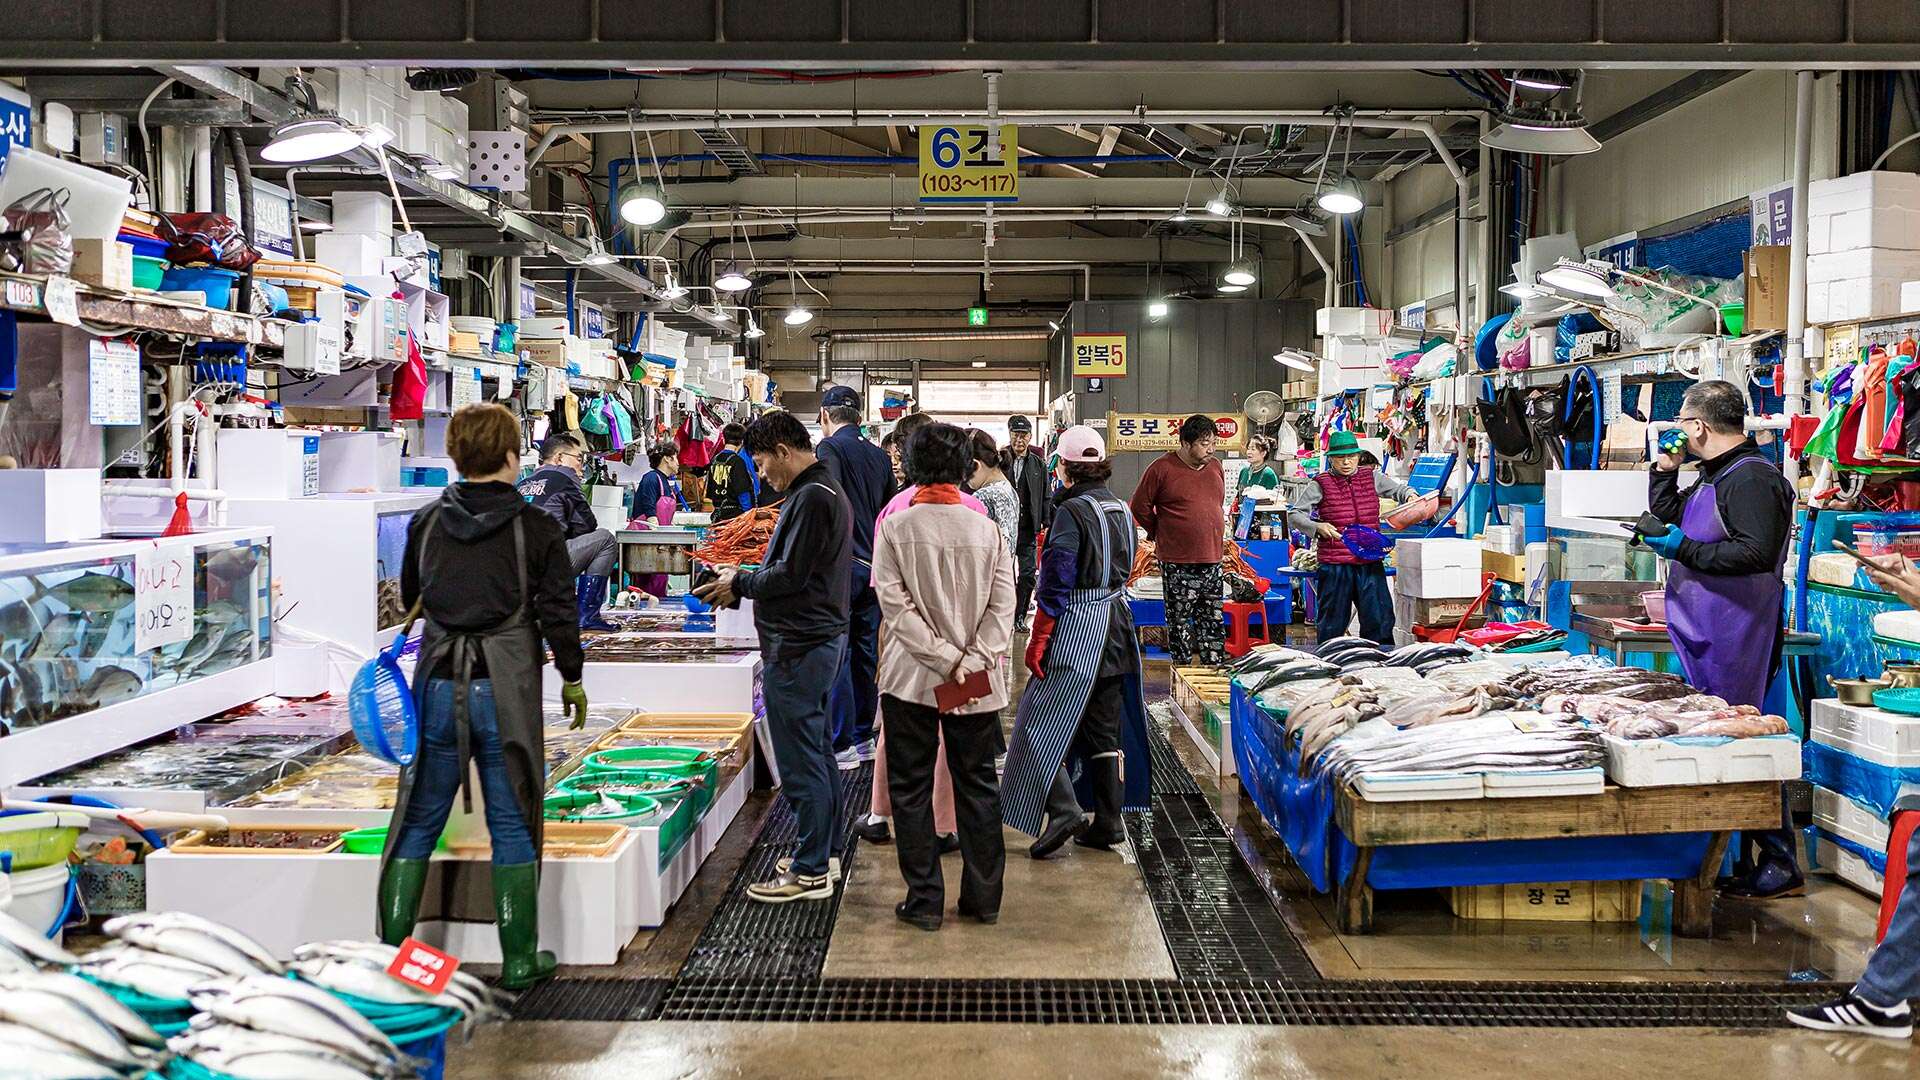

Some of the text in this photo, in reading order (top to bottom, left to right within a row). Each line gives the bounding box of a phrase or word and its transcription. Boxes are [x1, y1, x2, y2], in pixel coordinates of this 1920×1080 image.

[931, 127, 1005, 169] 6조
[922, 172, 1015, 194] (103~117)
[13, 284, 33, 303] 103
[1077, 345, 1123, 366] 할복5
